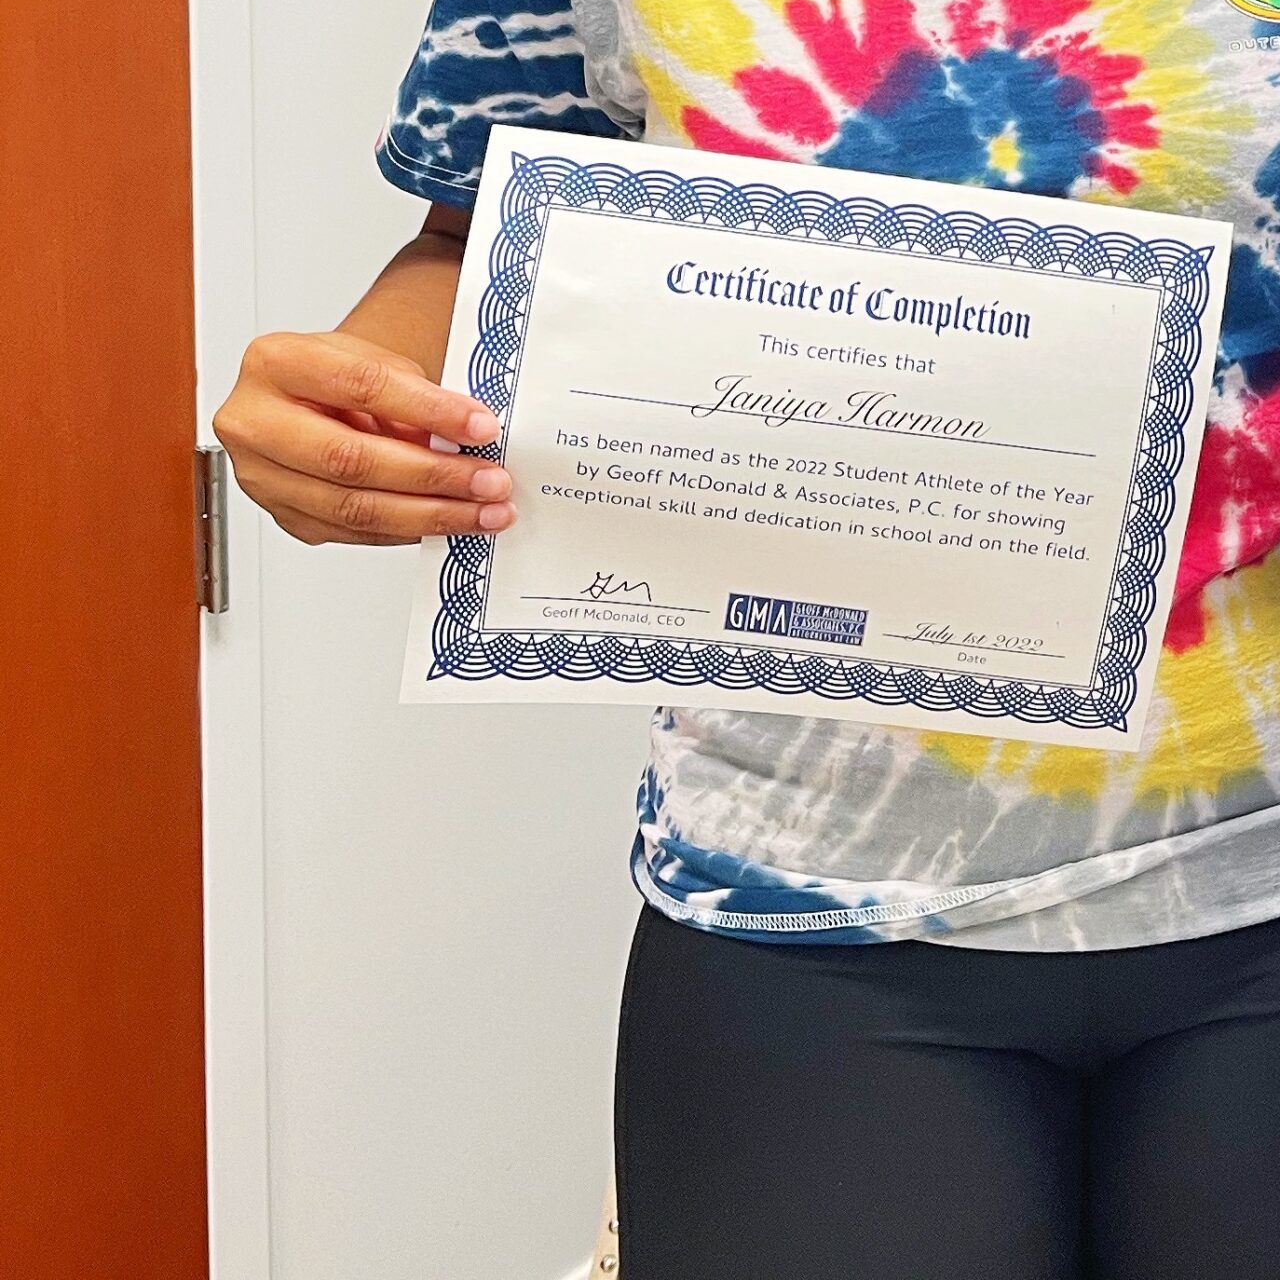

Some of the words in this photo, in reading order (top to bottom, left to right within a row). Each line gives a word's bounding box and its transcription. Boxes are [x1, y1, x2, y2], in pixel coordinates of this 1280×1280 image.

[666, 261, 824, 311] Certificate
[829, 281, 860, 315] of
[866, 287, 1031, 339] Completion
[759, 334, 799, 356] This
[807, 344, 887, 368] certifies
[895, 354, 936, 374] that
[691, 375, 832, 427] Janiya
[838, 390, 992, 439] Harmon
[556, 429, 588, 448] has
[597, 434, 643, 454] been
[650, 444, 714, 462] named
[720, 452, 740, 466] as
[749, 453, 778, 470] the
[785, 458, 827, 475] 2022
[833, 461, 908, 485] Student
[914, 471, 983, 494] Athlete
[990, 481, 1012, 496] of
[1017, 484, 1046, 501] the
[1053, 487, 1095, 506] Year
[577, 461, 599, 481] by
[607, 464, 663, 485] Geoff
[669, 472, 766, 496] McDonald
[773, 483, 787, 499] &
[795, 486, 900, 514] Associates,
[908, 499, 945, 517] P.C.
[954, 504, 981, 520] for
[987, 509, 1066, 535] showing
[541, 484, 652, 510] exceptional
[659, 499, 697, 516] skill
[703, 506, 737, 520] and
[744, 509, 841, 533] dedication
[849, 519, 864, 536] in
[871, 524, 932, 544] school
[939, 533, 973, 548] and
[979, 537, 1002, 551] on
[1009, 539, 1039, 556] the
[1046, 542, 1090, 562] field.
[542, 606, 580, 620] Geoff
[584, 608, 652, 625] McDonald,
[657, 615, 685, 627] CEO
[730, 597, 786, 634] GMA
[845, 635, 861, 645] LAW
[904, 622, 955, 645] July
[962, 632, 986, 645] 1st
[992, 634, 1044, 651] 2022
[957, 652, 987, 665] Date
